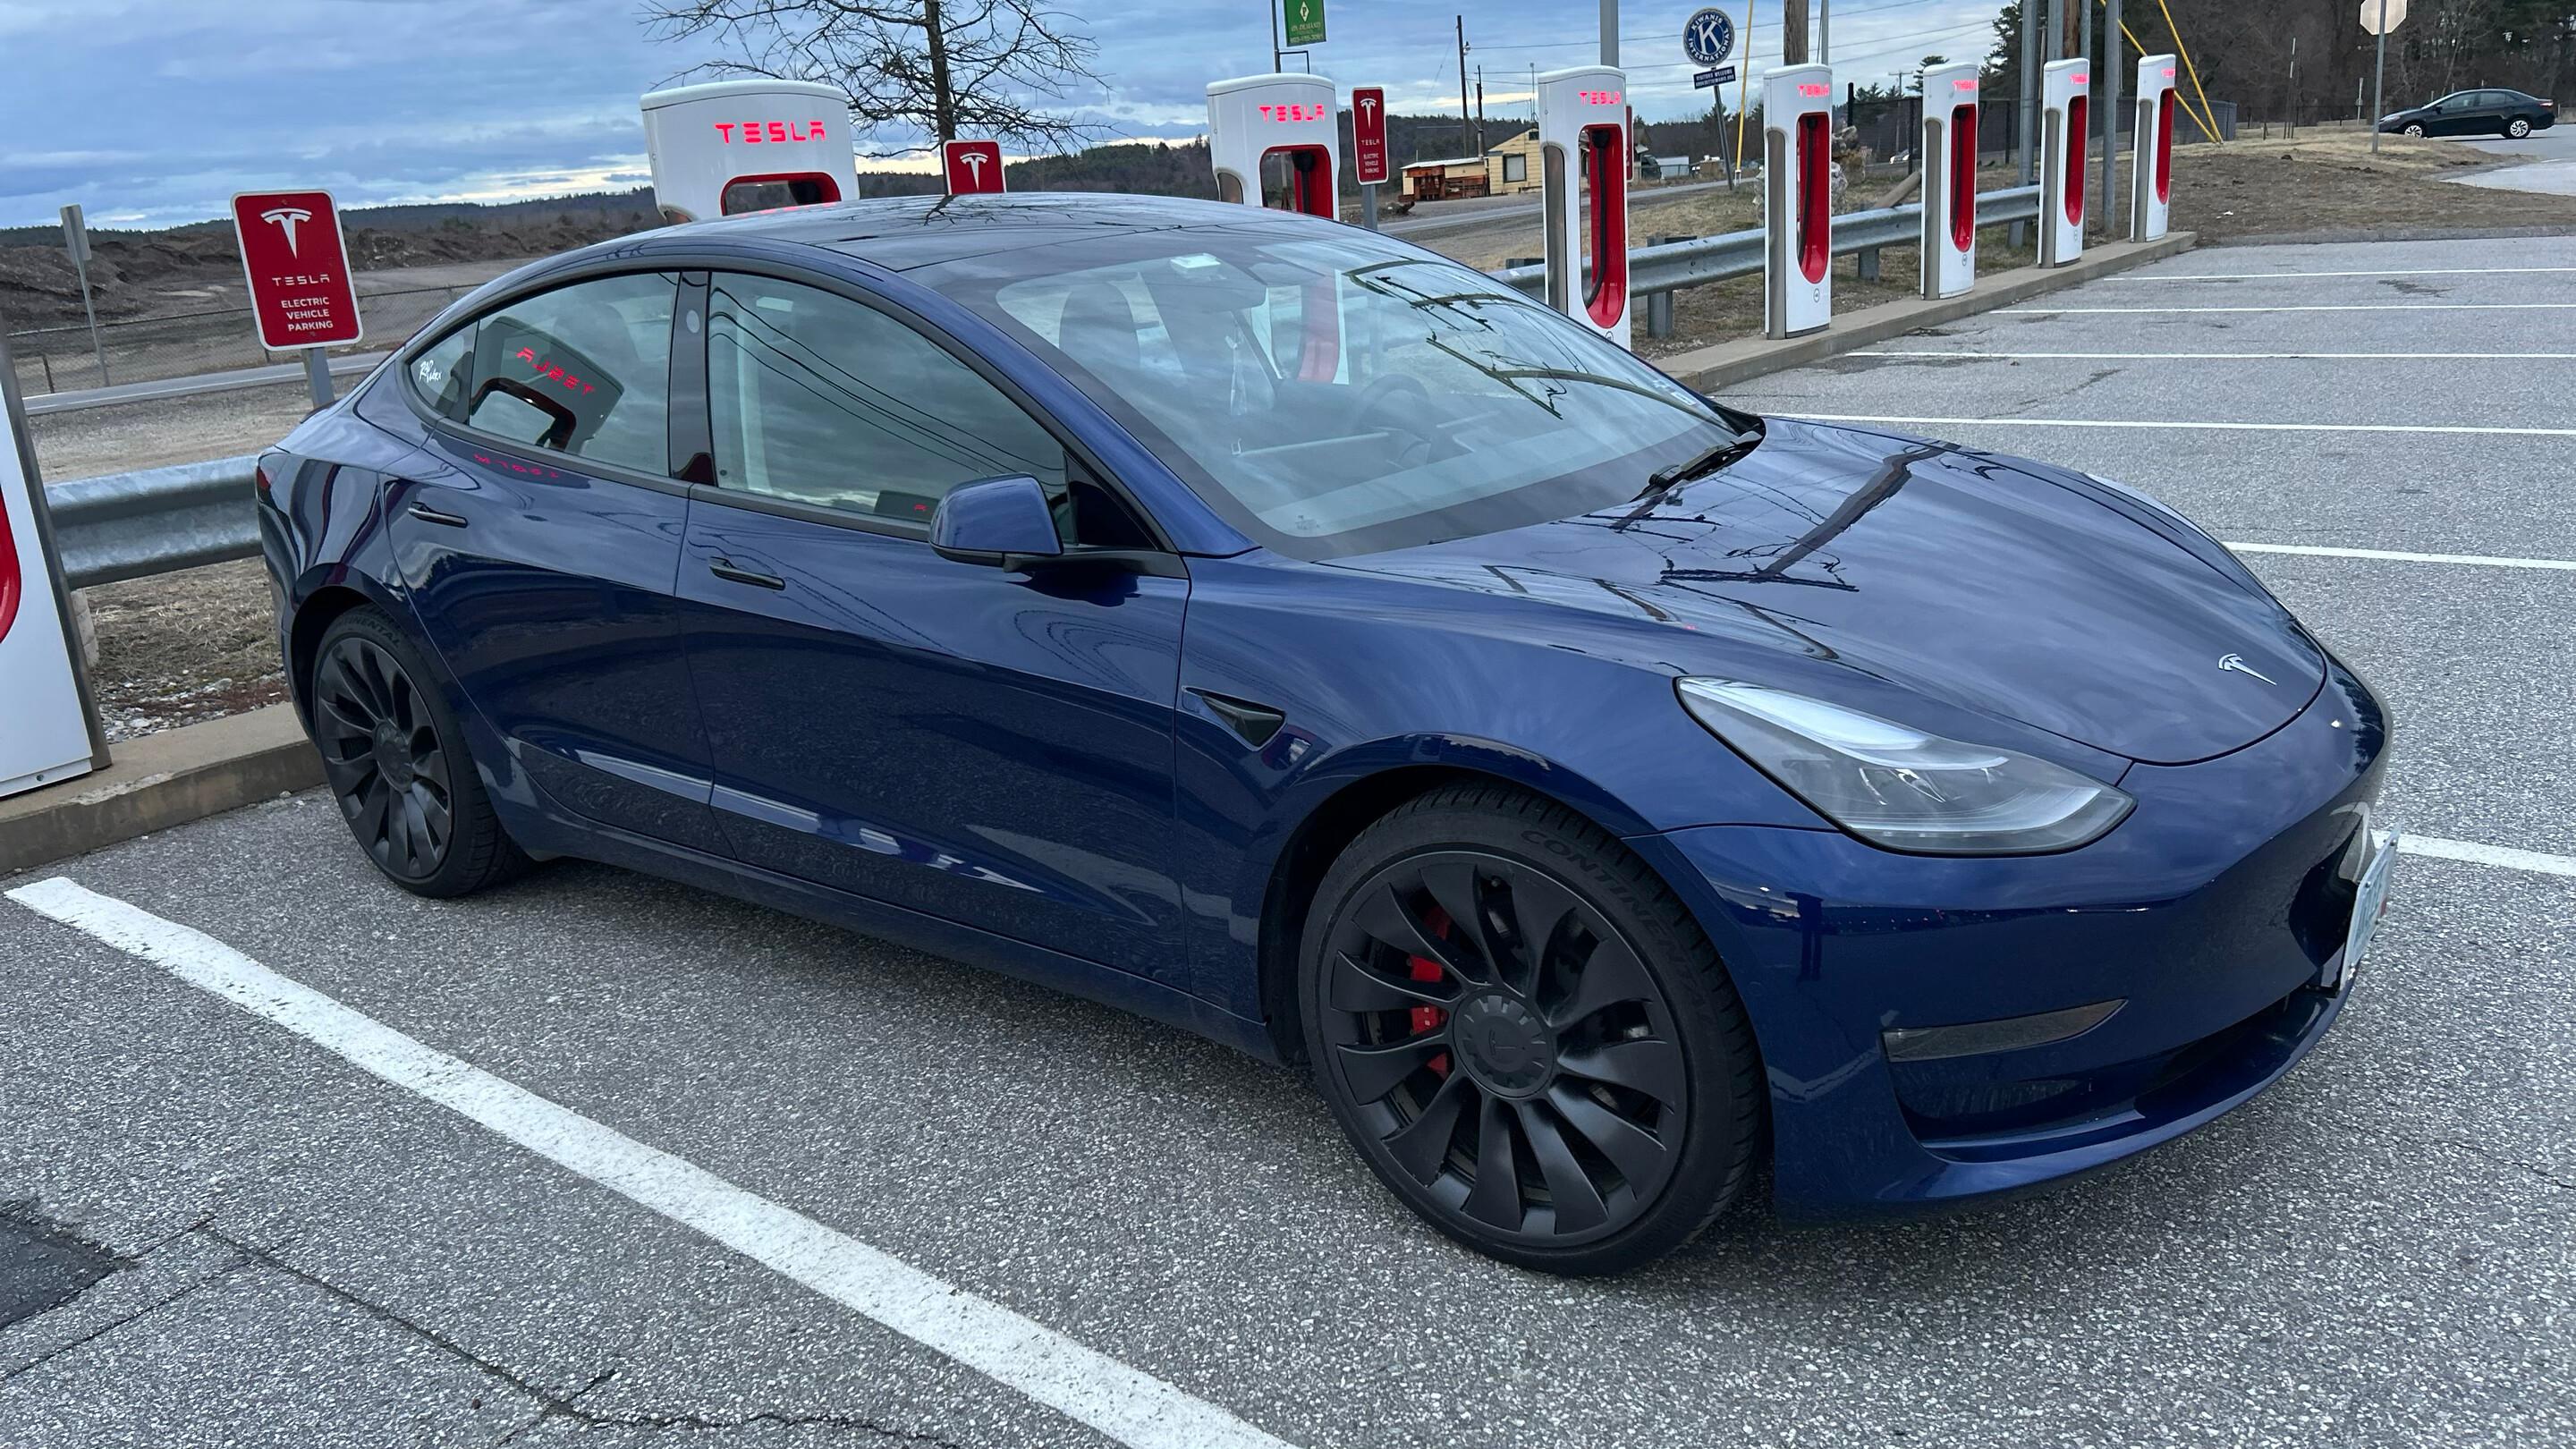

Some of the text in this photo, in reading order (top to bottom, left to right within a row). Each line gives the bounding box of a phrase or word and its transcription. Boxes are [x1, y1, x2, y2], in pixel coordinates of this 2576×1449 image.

[1690, 13, 1724, 31] KIWANIS
[1688, 28, 1730, 62] INTERNATIONAL
[1698, 21, 1722, 55] K
[1578, 90, 1623, 106] TESLA
[1258, 104, 1326, 123] TESLA
[714, 121, 826, 144] TESLA
[271, 274, 330, 287] TESLA
[280, 296, 330, 309] ELECTRIC
[285, 309, 330, 320] VEHICLE
[287, 320, 334, 332] PARKING
